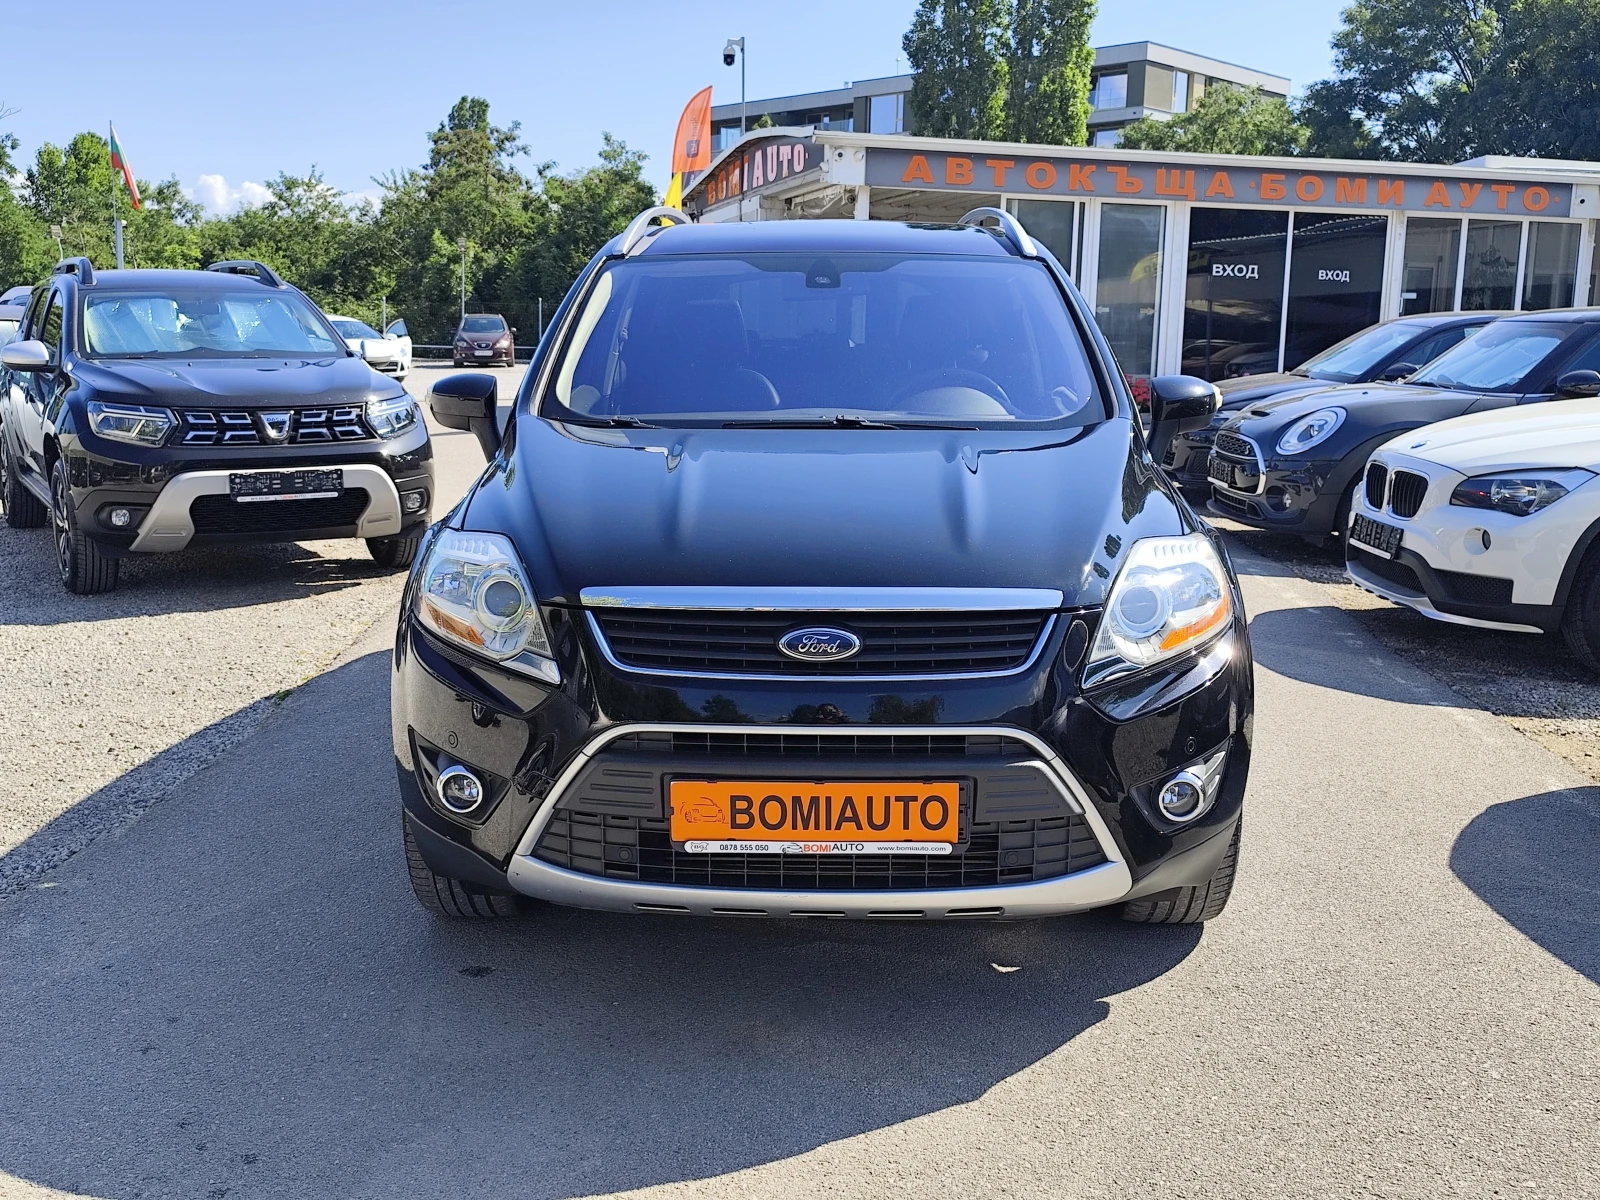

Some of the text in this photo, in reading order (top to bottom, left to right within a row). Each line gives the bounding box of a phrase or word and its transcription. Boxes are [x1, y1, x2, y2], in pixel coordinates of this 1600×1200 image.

[902, 155, 1235, 201] АВТОКЪЩА
[1212, 263, 1259, 280] ВХОД
[1318, 269, 1350, 283] ВХОД
[798, 634, 841, 653] Ford
[729, 795, 949, 831] BOMIAUTO
[754, 844, 769, 852] 050
